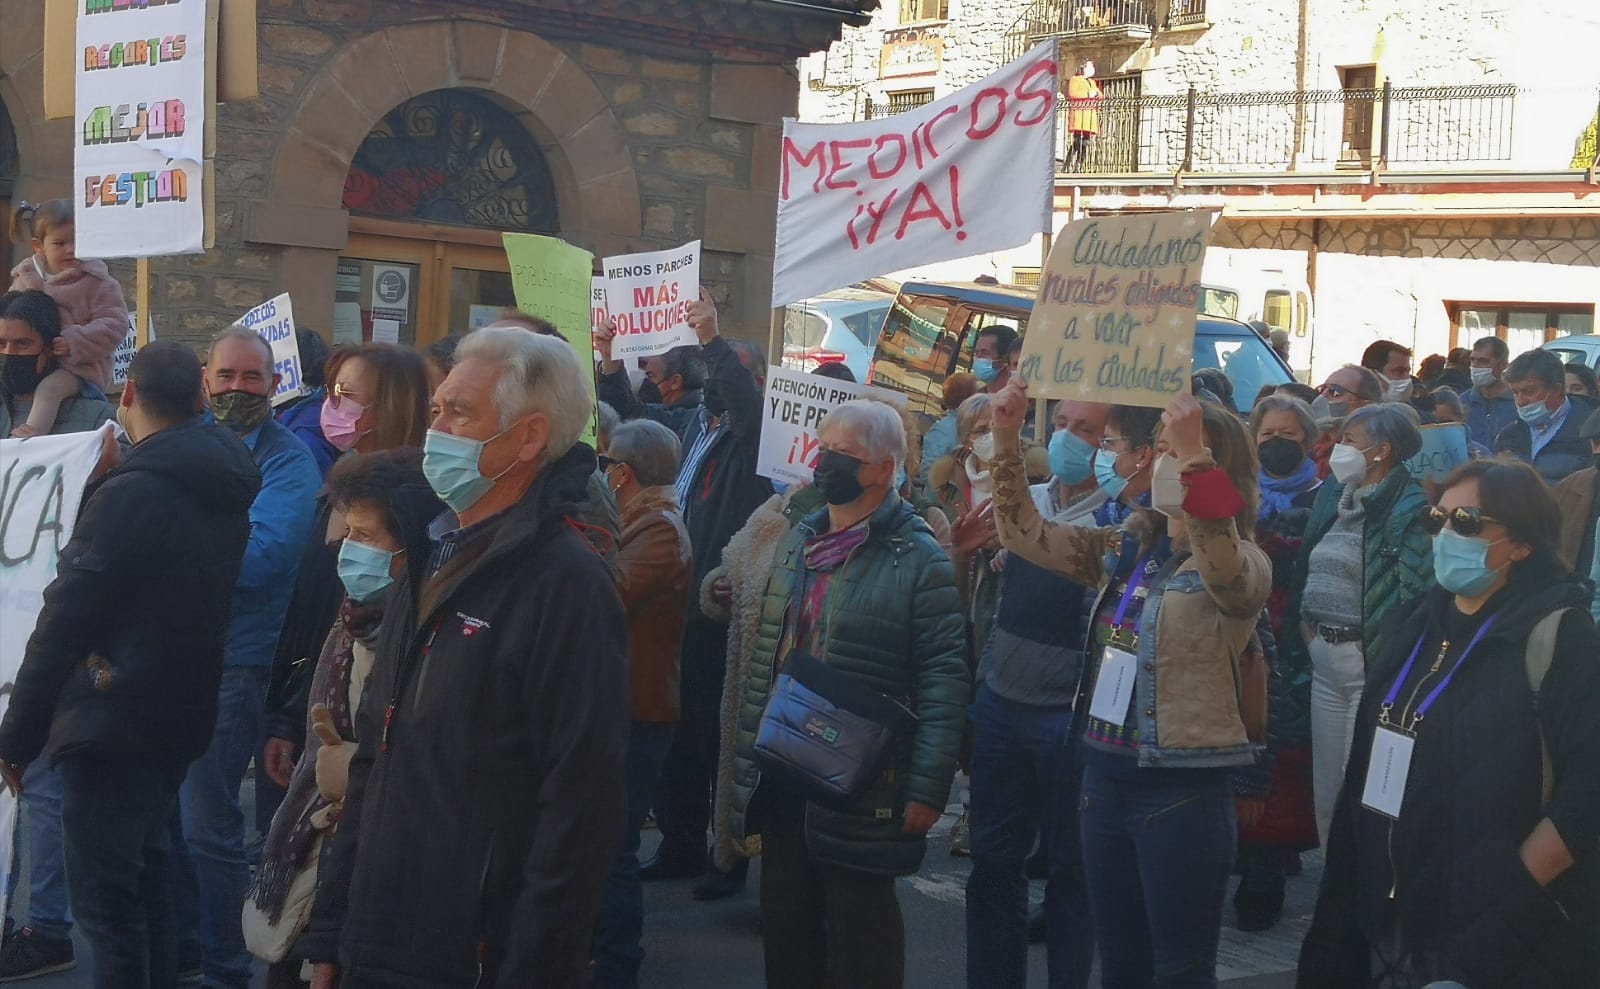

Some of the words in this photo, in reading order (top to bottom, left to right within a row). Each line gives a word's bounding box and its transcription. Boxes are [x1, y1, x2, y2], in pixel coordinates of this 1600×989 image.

[782, 59, 1058, 200] MEDICOS
[847, 165, 966, 250] ¡YA!
[608, 265, 651, 280] MENOS
[656, 254, 693, 274] PARCHES
[633, 280, 678, 307] MÁS
[1065, 317, 1080, 340] a
[1020, 352, 1041, 381] en
[1054, 347, 1083, 383] las
[1096, 345, 1184, 392] ciudades
[771, 377, 826, 400] ATENCIÓN
[770, 397, 780, 419] Y
[782, 400, 801, 425] DE
